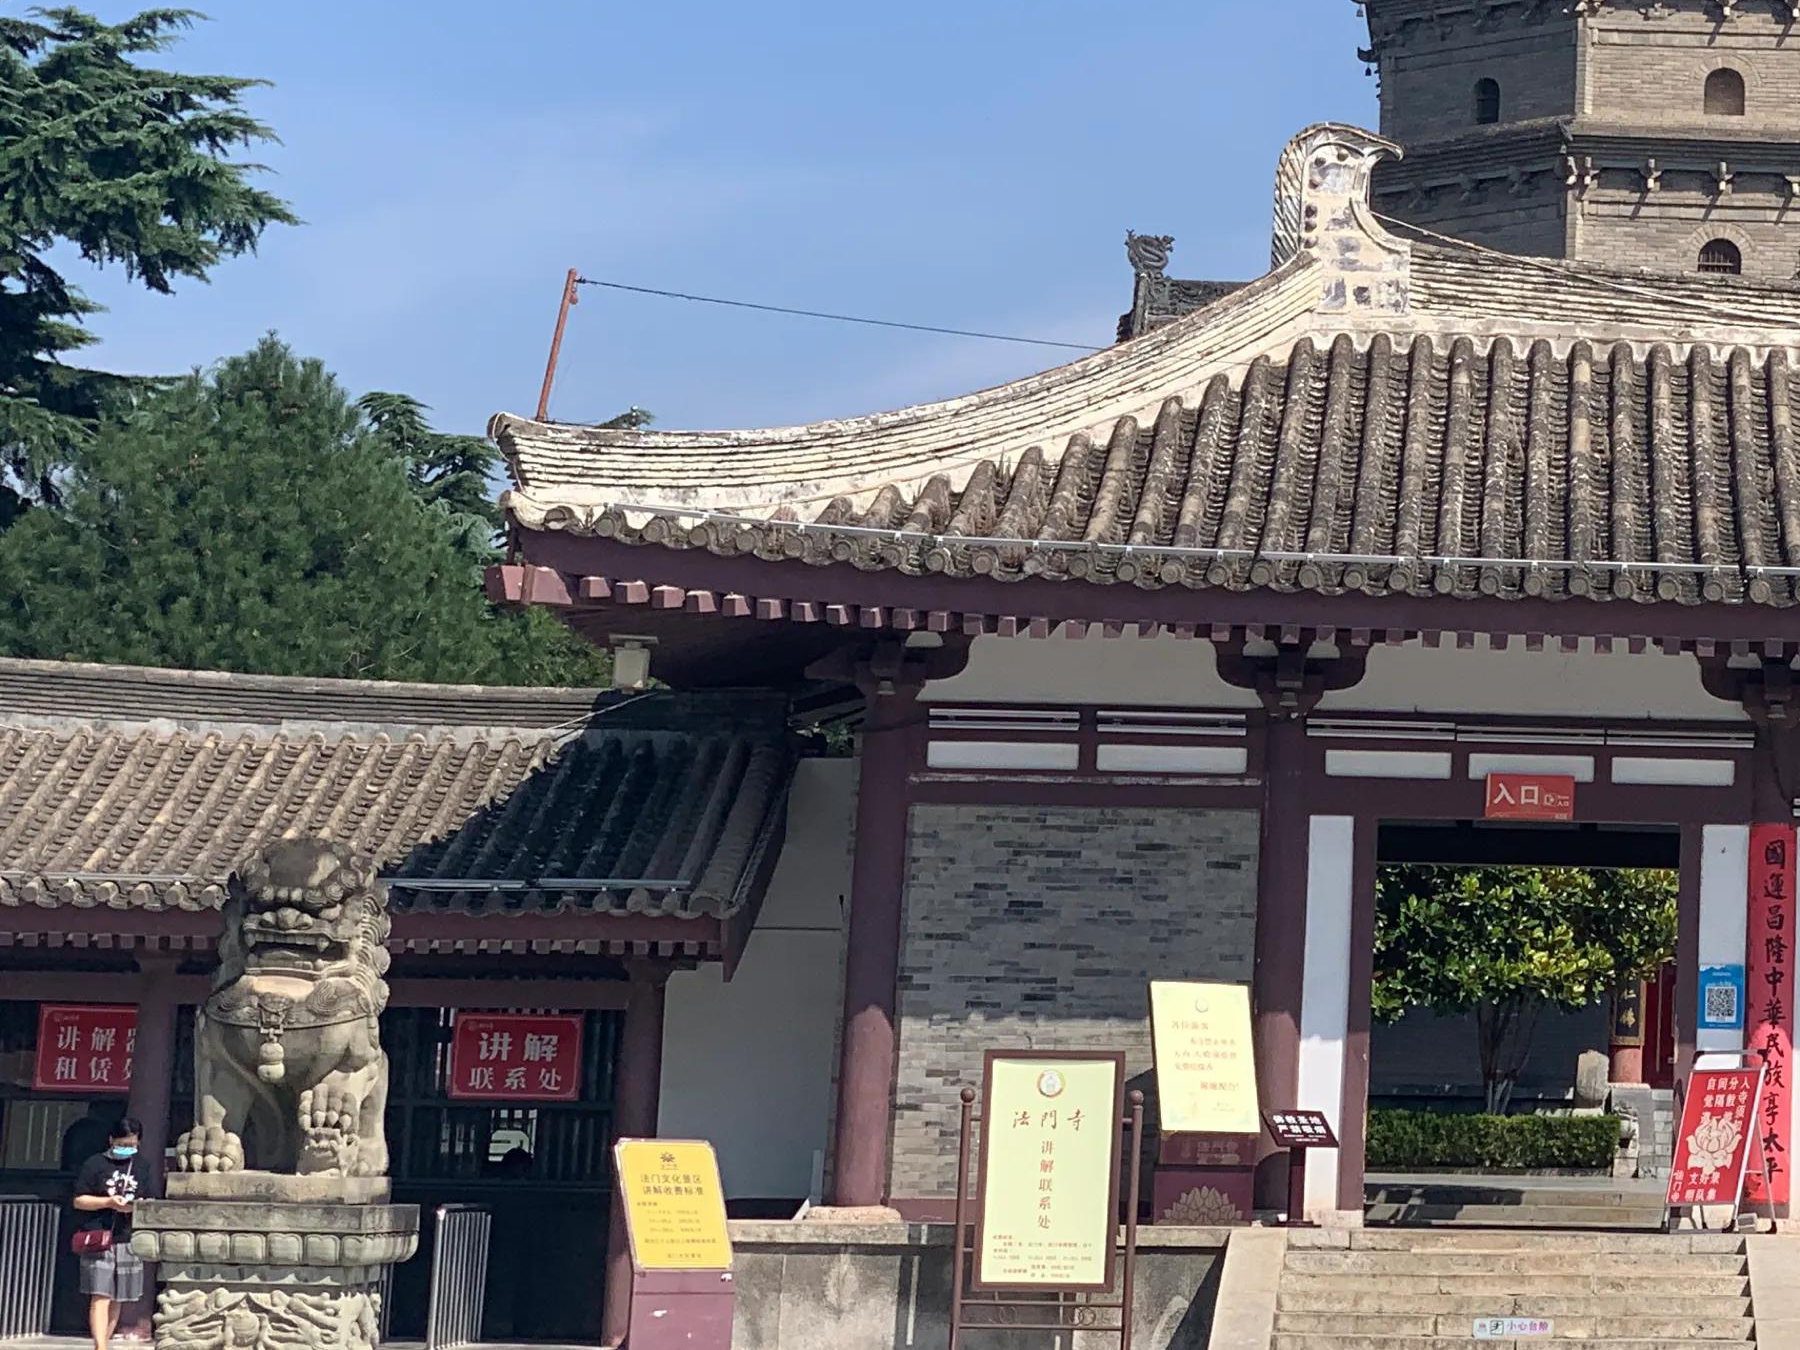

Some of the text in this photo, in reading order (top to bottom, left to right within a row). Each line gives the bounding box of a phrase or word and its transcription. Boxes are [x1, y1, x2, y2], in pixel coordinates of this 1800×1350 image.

[1493, 782, 1539, 805] 入口
[479, 1032, 559, 1062] 讲解
[468, 1066, 562, 1091] 联系处
[1012, 1109, 1086, 1132] 法門寺
